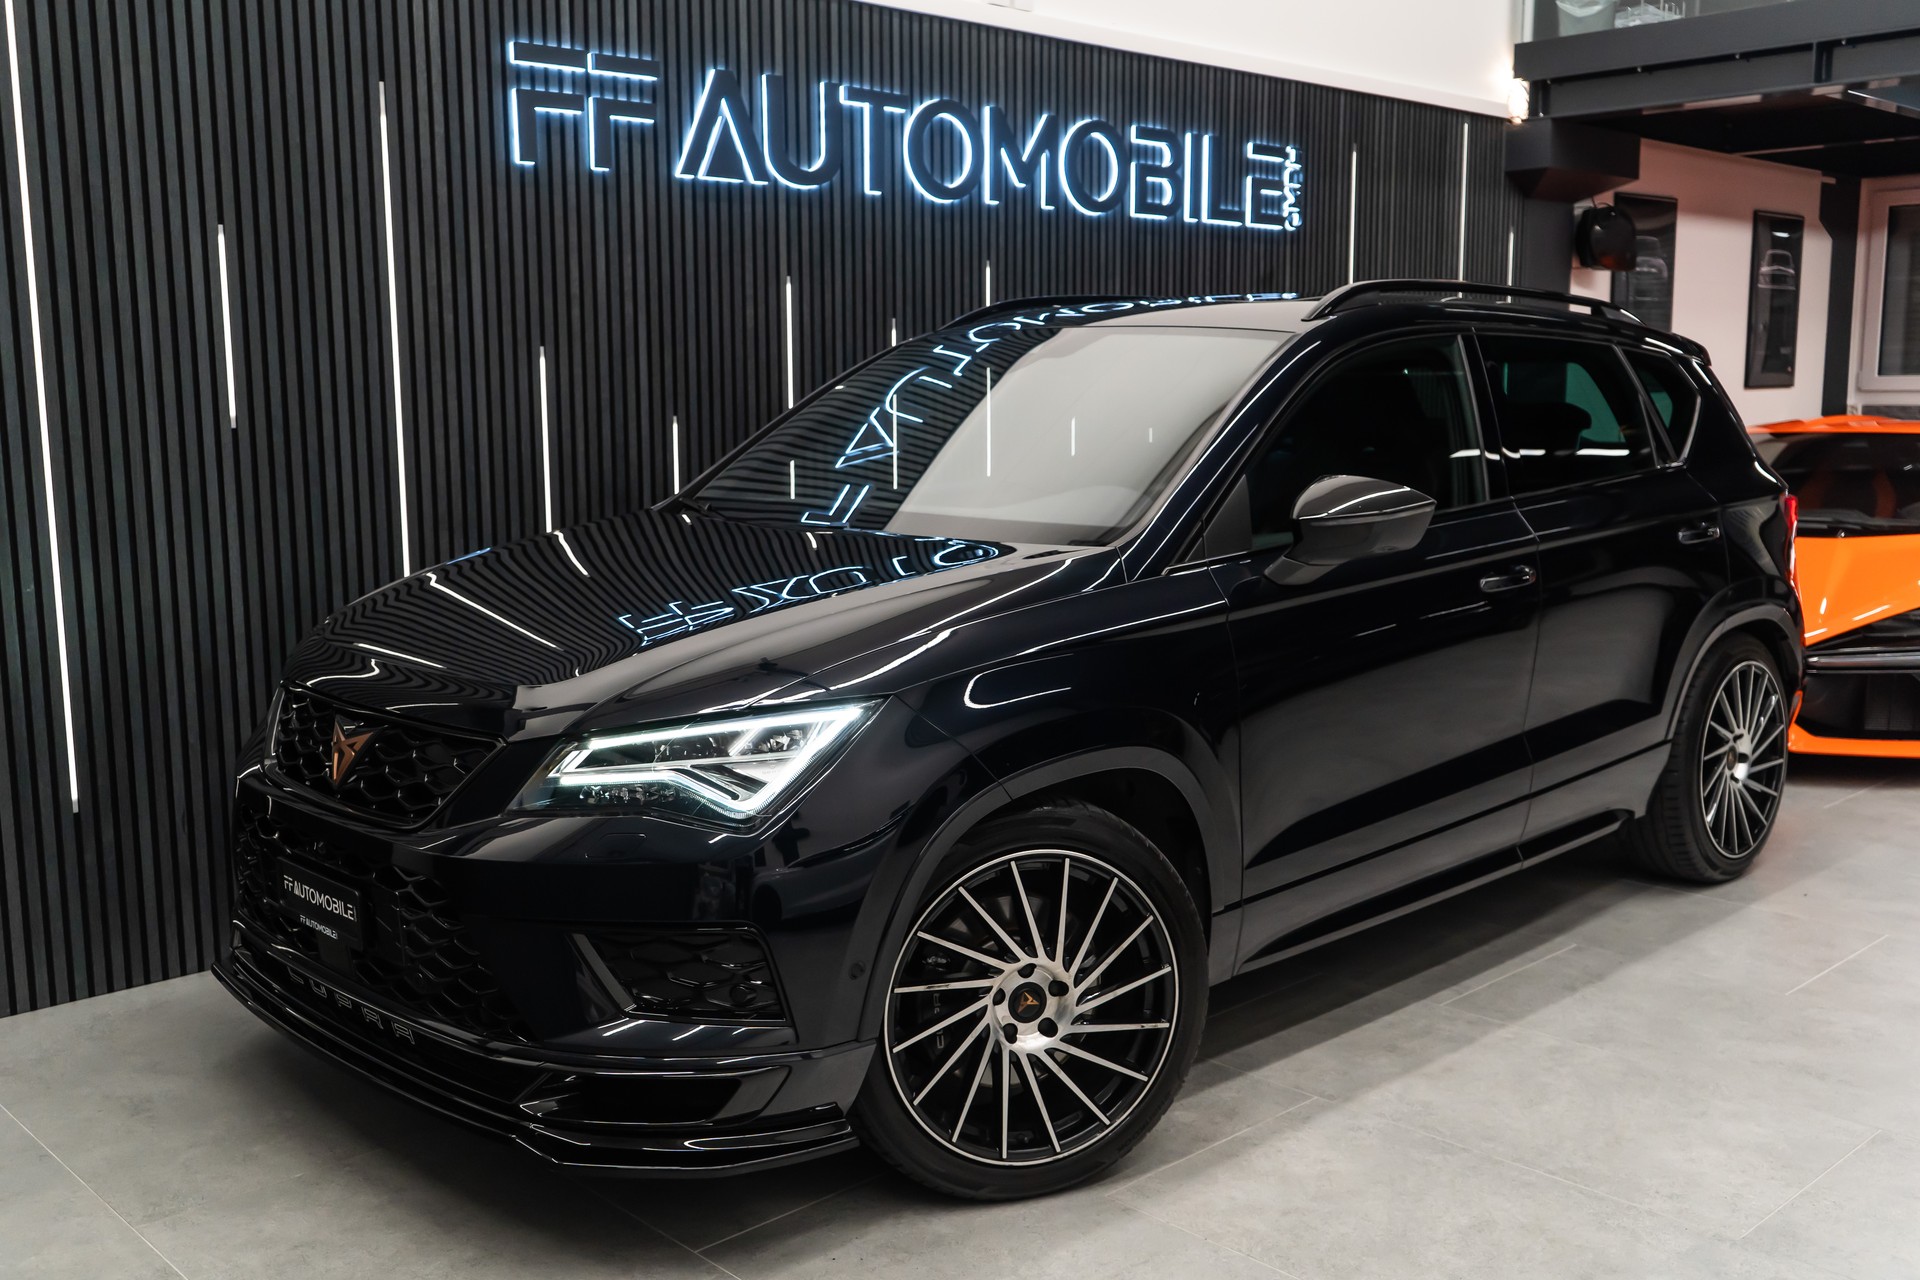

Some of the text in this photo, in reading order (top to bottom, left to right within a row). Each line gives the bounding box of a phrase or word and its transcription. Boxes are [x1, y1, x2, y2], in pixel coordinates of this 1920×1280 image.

[508, 40, 1285, 231] FF AUTOMOBILE
[283, 874, 293, 892] FF
[293, 881, 354, 920] AUTOMOBILE
[305, 917, 337, 939] AUTOMOBILE
